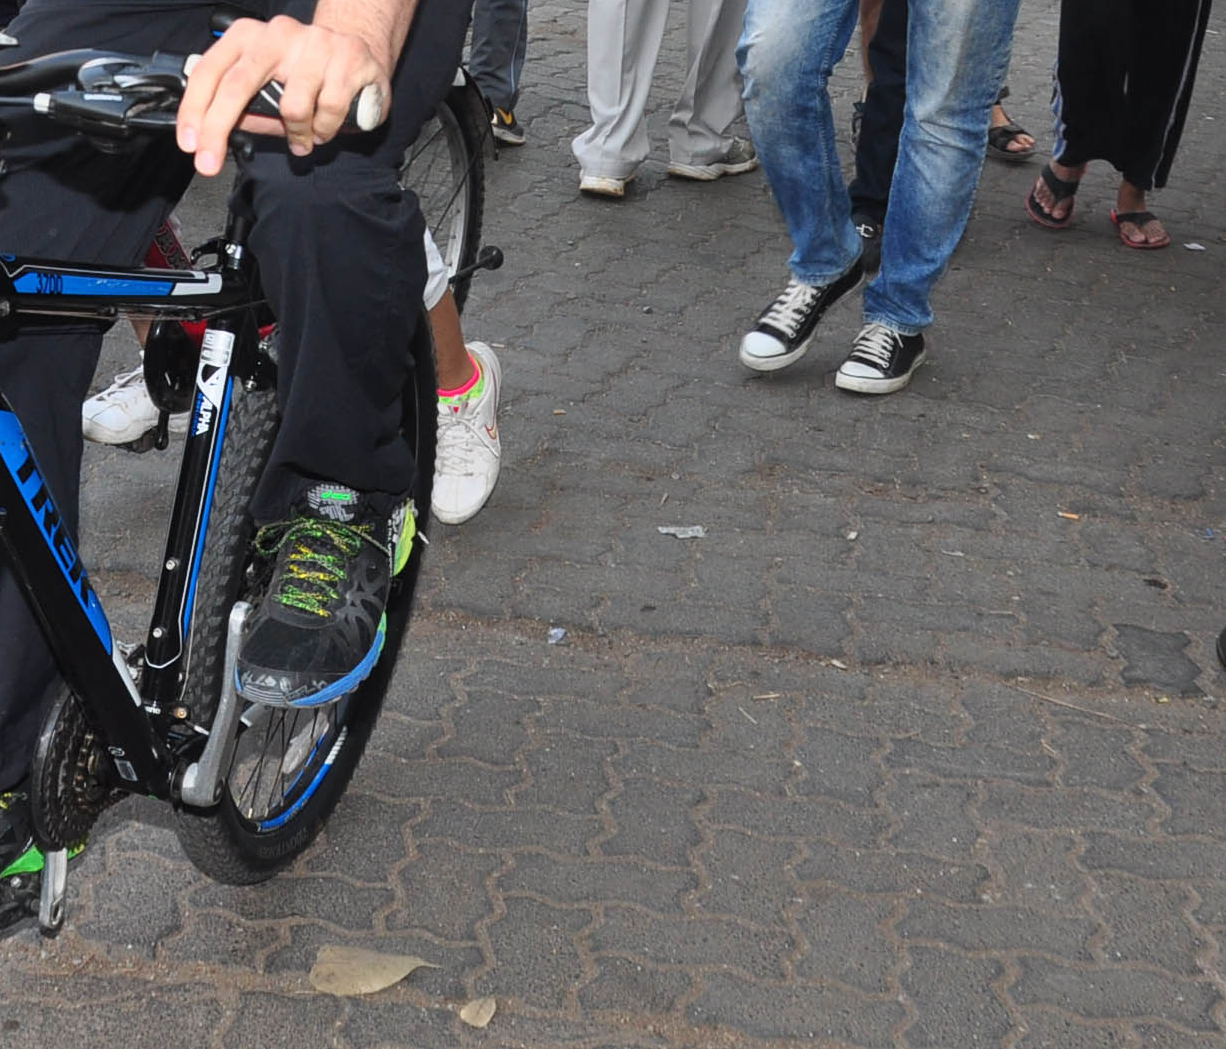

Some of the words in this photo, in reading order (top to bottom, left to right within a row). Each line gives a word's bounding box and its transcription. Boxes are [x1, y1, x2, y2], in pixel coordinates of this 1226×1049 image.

[36, 273, 63, 294] 3700
[195, 395, 214, 435] ALPHA
[15, 450, 92, 609] TREK
